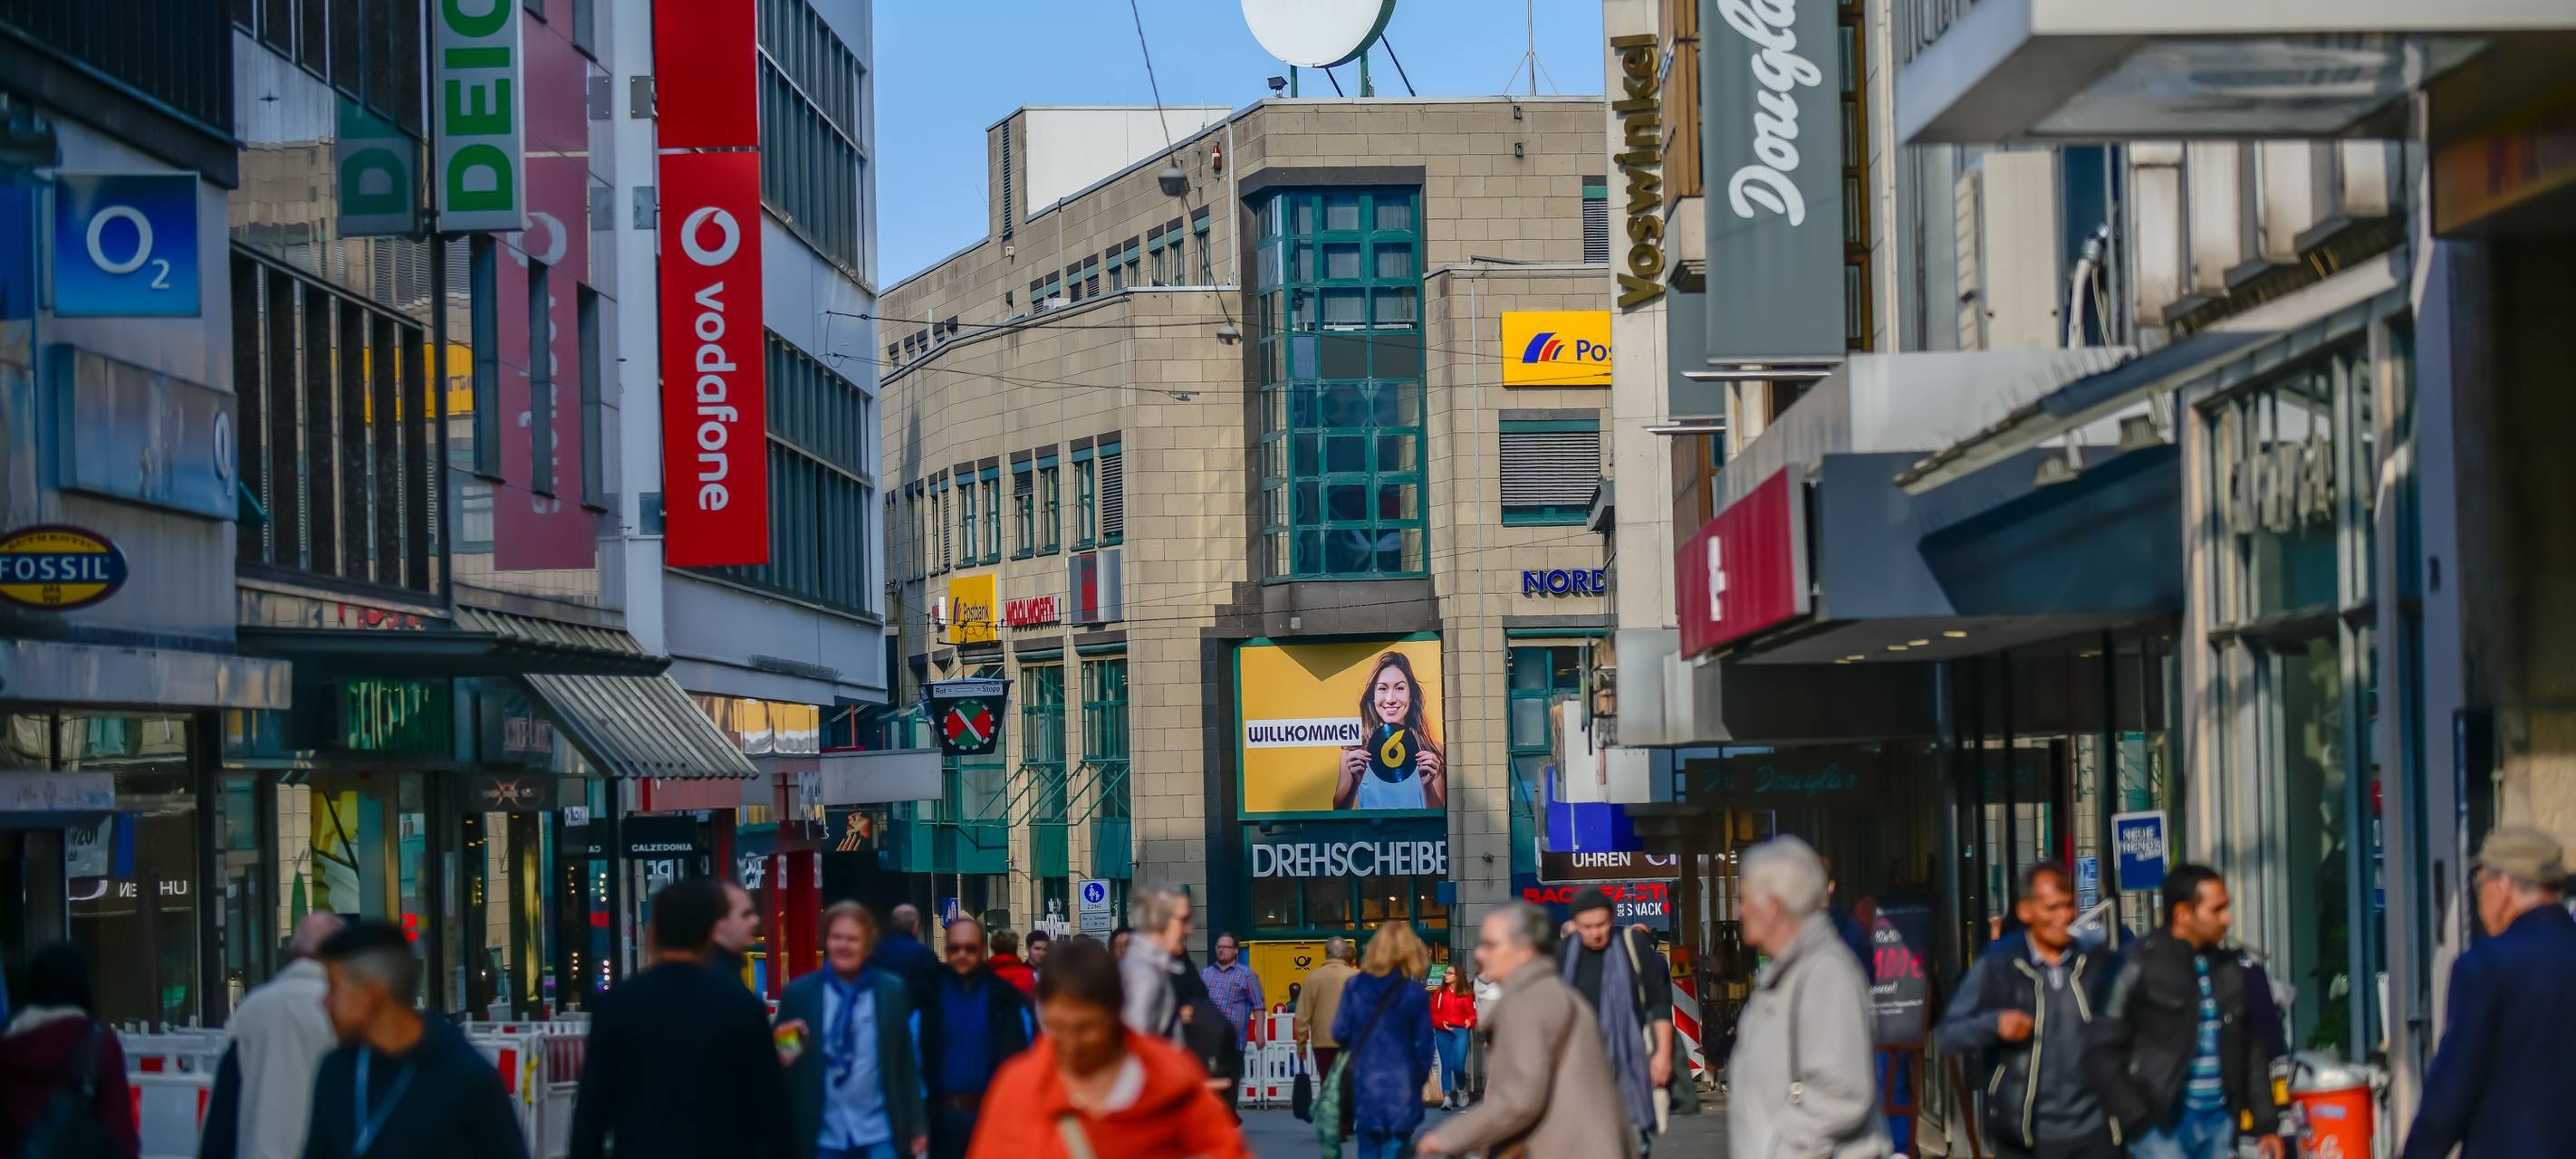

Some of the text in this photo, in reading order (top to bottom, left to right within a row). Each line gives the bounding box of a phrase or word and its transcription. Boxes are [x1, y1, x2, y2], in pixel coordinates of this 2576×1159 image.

[1610, 34, 1666, 309] Voswinkel
[1576, 339, 1611, 362] Po
[694, 281, 739, 512] vodafone
[0, 556, 109, 580] FOSSIL
[964, 599, 989, 622] Postbank
[1004, 595, 1055, 626] WOOLWORTH
[982, 685, 1001, 694] Stopp
[1247, 723, 1360, 742] WILLKOMMEN
[2122, 825, 2157, 842] NEUE
[631, 842, 693, 853] CALZEDONIA
[1253, 840, 1447, 877] DREHSCHEIBE
